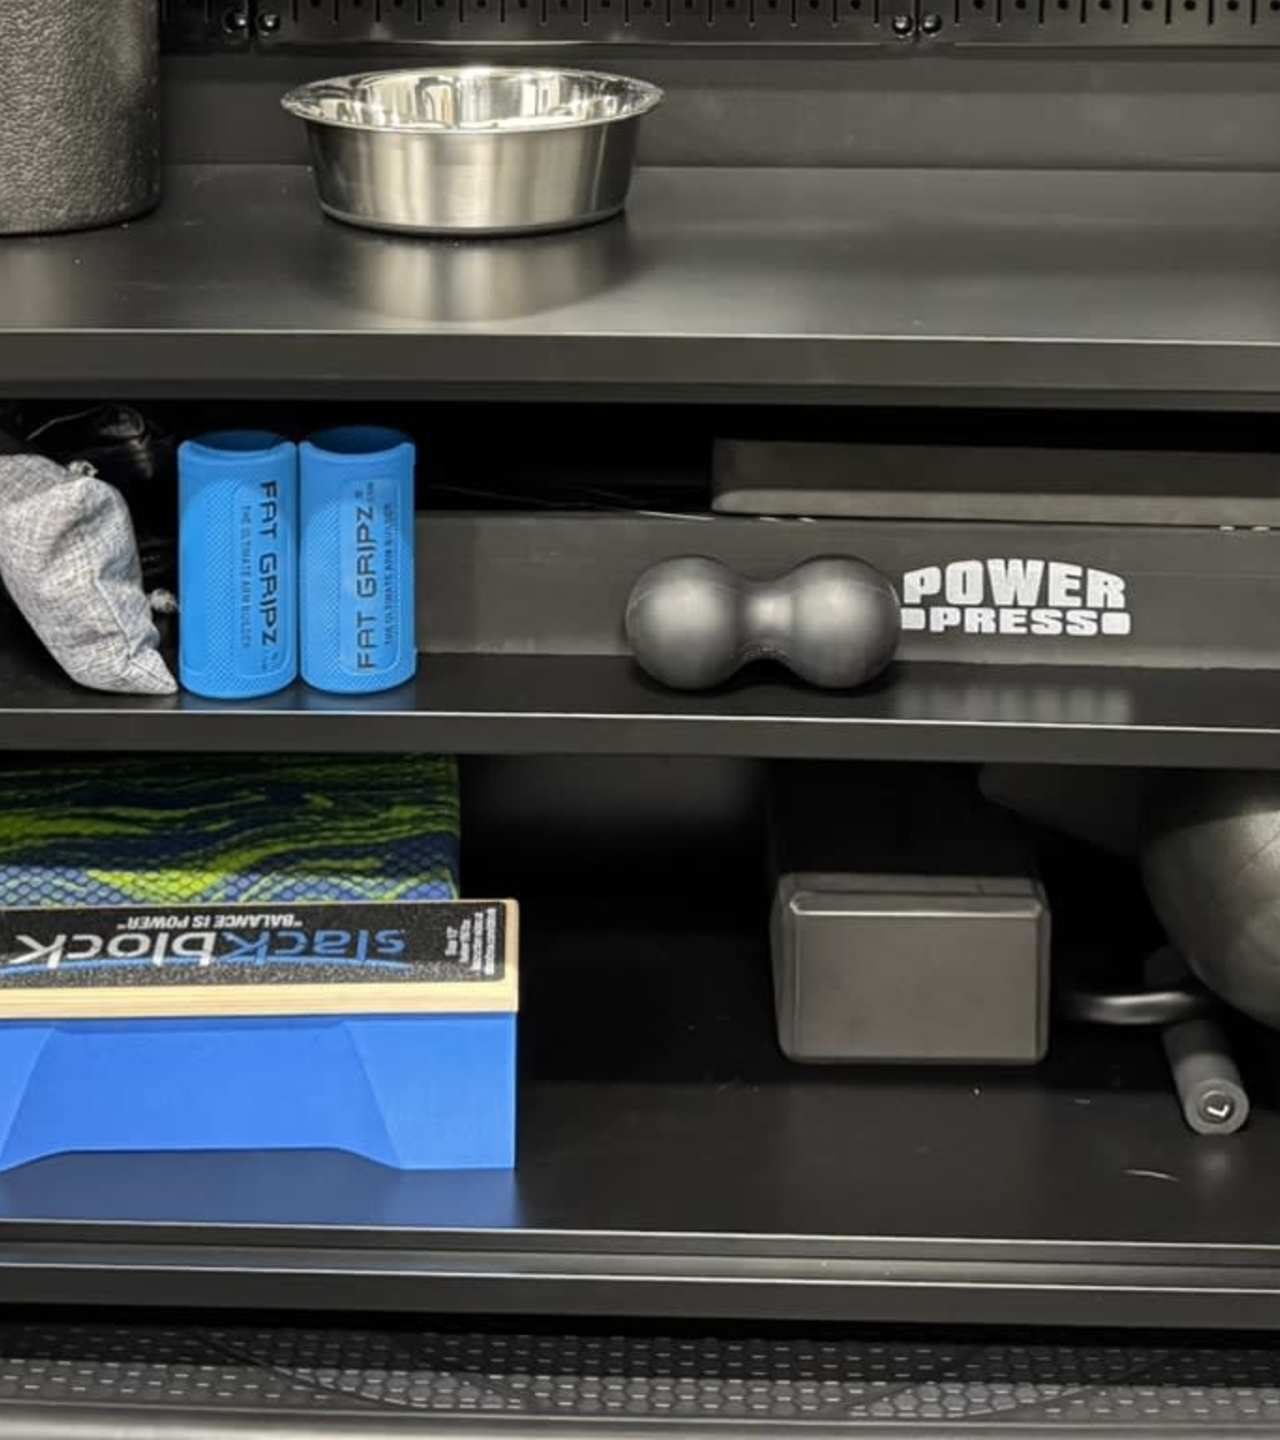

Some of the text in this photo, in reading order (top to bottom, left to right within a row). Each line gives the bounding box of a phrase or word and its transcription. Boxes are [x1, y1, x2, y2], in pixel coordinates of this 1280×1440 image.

[259, 480, 277, 539] FAT
[357, 507, 376, 598] GRIPZ
[259, 552, 277, 645] GRIPZ
[904, 558, 1125, 609] POWER
[357, 611, 376, 669] FAT
[930, 607, 1098, 636] PRESS
[191, 914, 210, 928] IS
